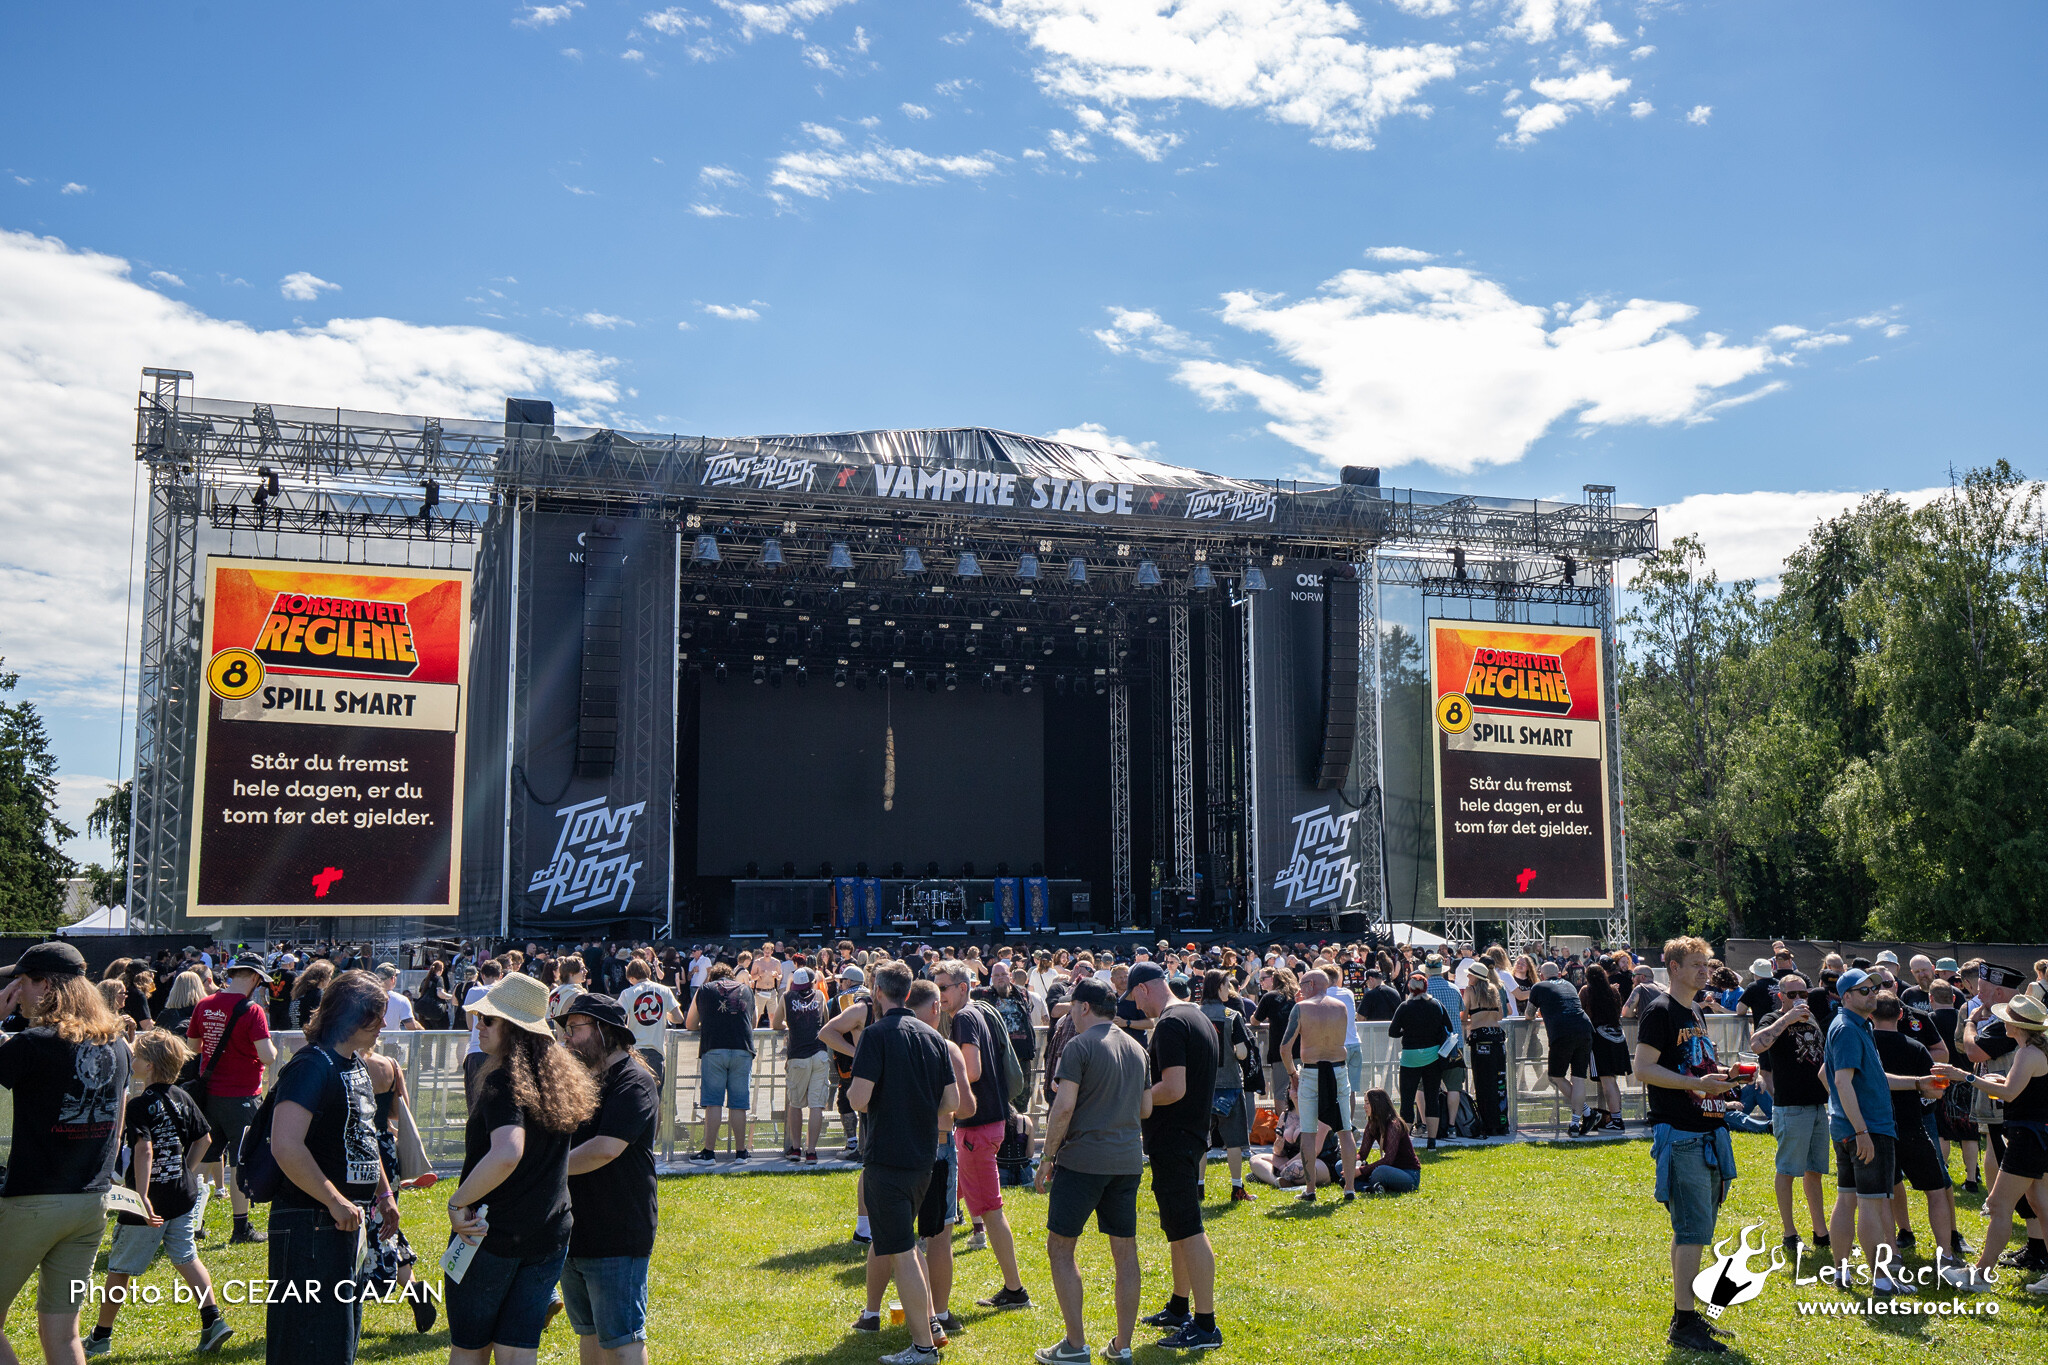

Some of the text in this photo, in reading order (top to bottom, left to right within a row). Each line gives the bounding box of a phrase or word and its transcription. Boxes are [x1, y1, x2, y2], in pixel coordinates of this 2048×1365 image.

[701, 452, 758, 485] TONS
[751, 455, 817, 492] ROCK
[874, 463, 1134, 515] VAMPIRE STAGE
[1184, 488, 1229, 519] TONS
[1224, 490, 1277, 523] ROCK
[273, 593, 406, 624] KONSERTVETT
[1291, 591, 1323, 602] NORW
[255, 613, 417, 662] REGLENE
[222, 659, 249, 688] 8
[1474, 648, 1561, 672] KONSERTVETT
[1466, 665, 1571, 704] REGLENE
[262, 686, 416, 716] SPILL SMART
[1445, 702, 1463, 724] 8
[1473, 723, 1573, 747] SPILL SMART
[250, 752, 409, 772] Står du fremst
[233, 779, 423, 801] hele dagen, er du
[1469, 776, 1573, 792] Står du fremst
[222, 807, 434, 829] tom før det gjelder.
[1459, 797, 1583, 816] hele dagen, er du
[551, 795, 646, 863] TONS
[1290, 805, 1360, 864] TONS
[1454, 820, 1593, 838] tom før det gjelder.
[527, 851, 643, 913] ROCK
[1273, 853, 1360, 908] ROCK
